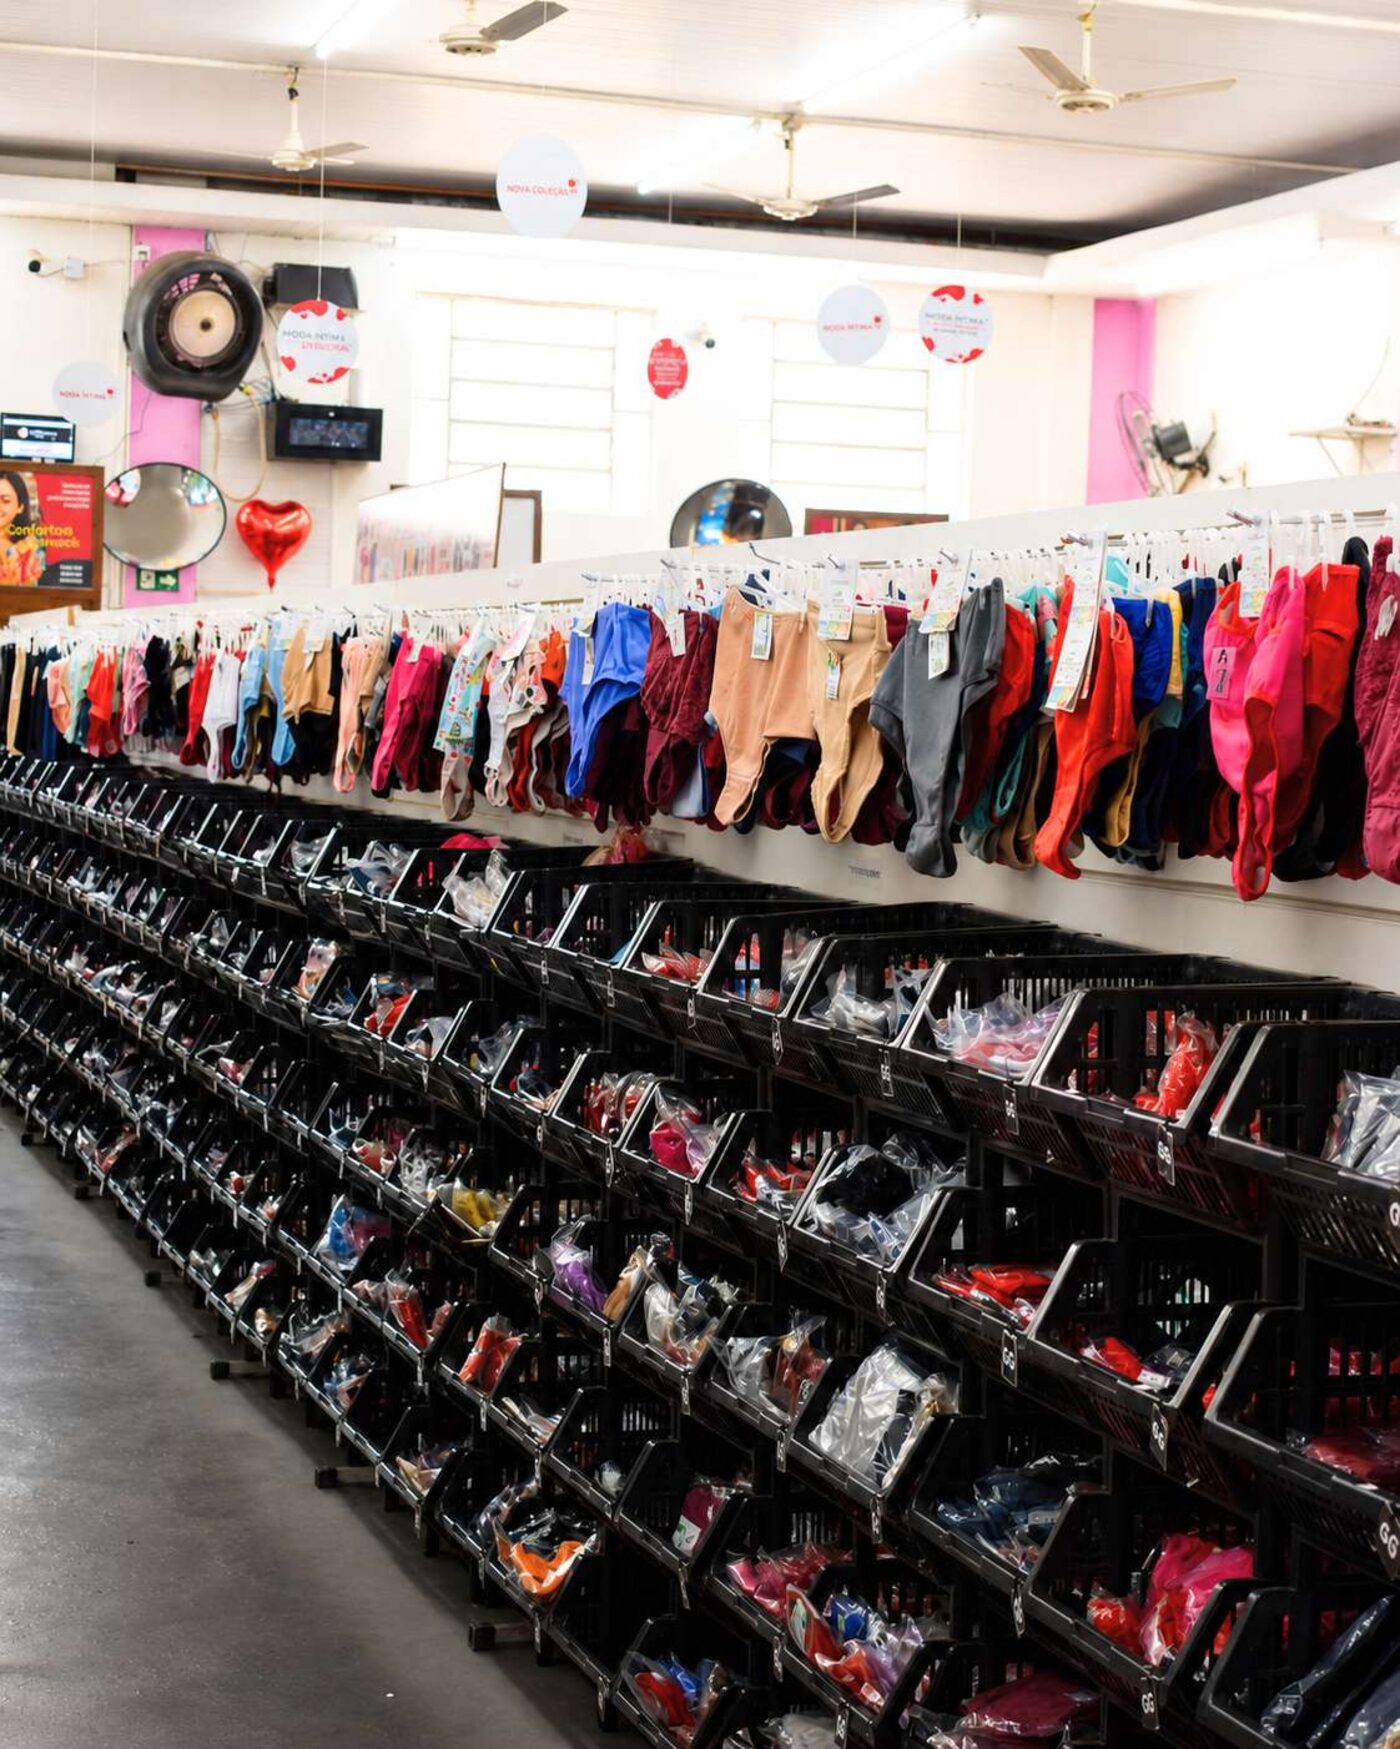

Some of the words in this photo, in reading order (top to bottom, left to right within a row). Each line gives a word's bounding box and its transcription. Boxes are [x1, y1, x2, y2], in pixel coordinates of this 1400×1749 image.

[282, 329, 312, 340] MODA
[1379, 1521, 1400, 1560] GG
[1141, 1692, 1155, 1714] GG
